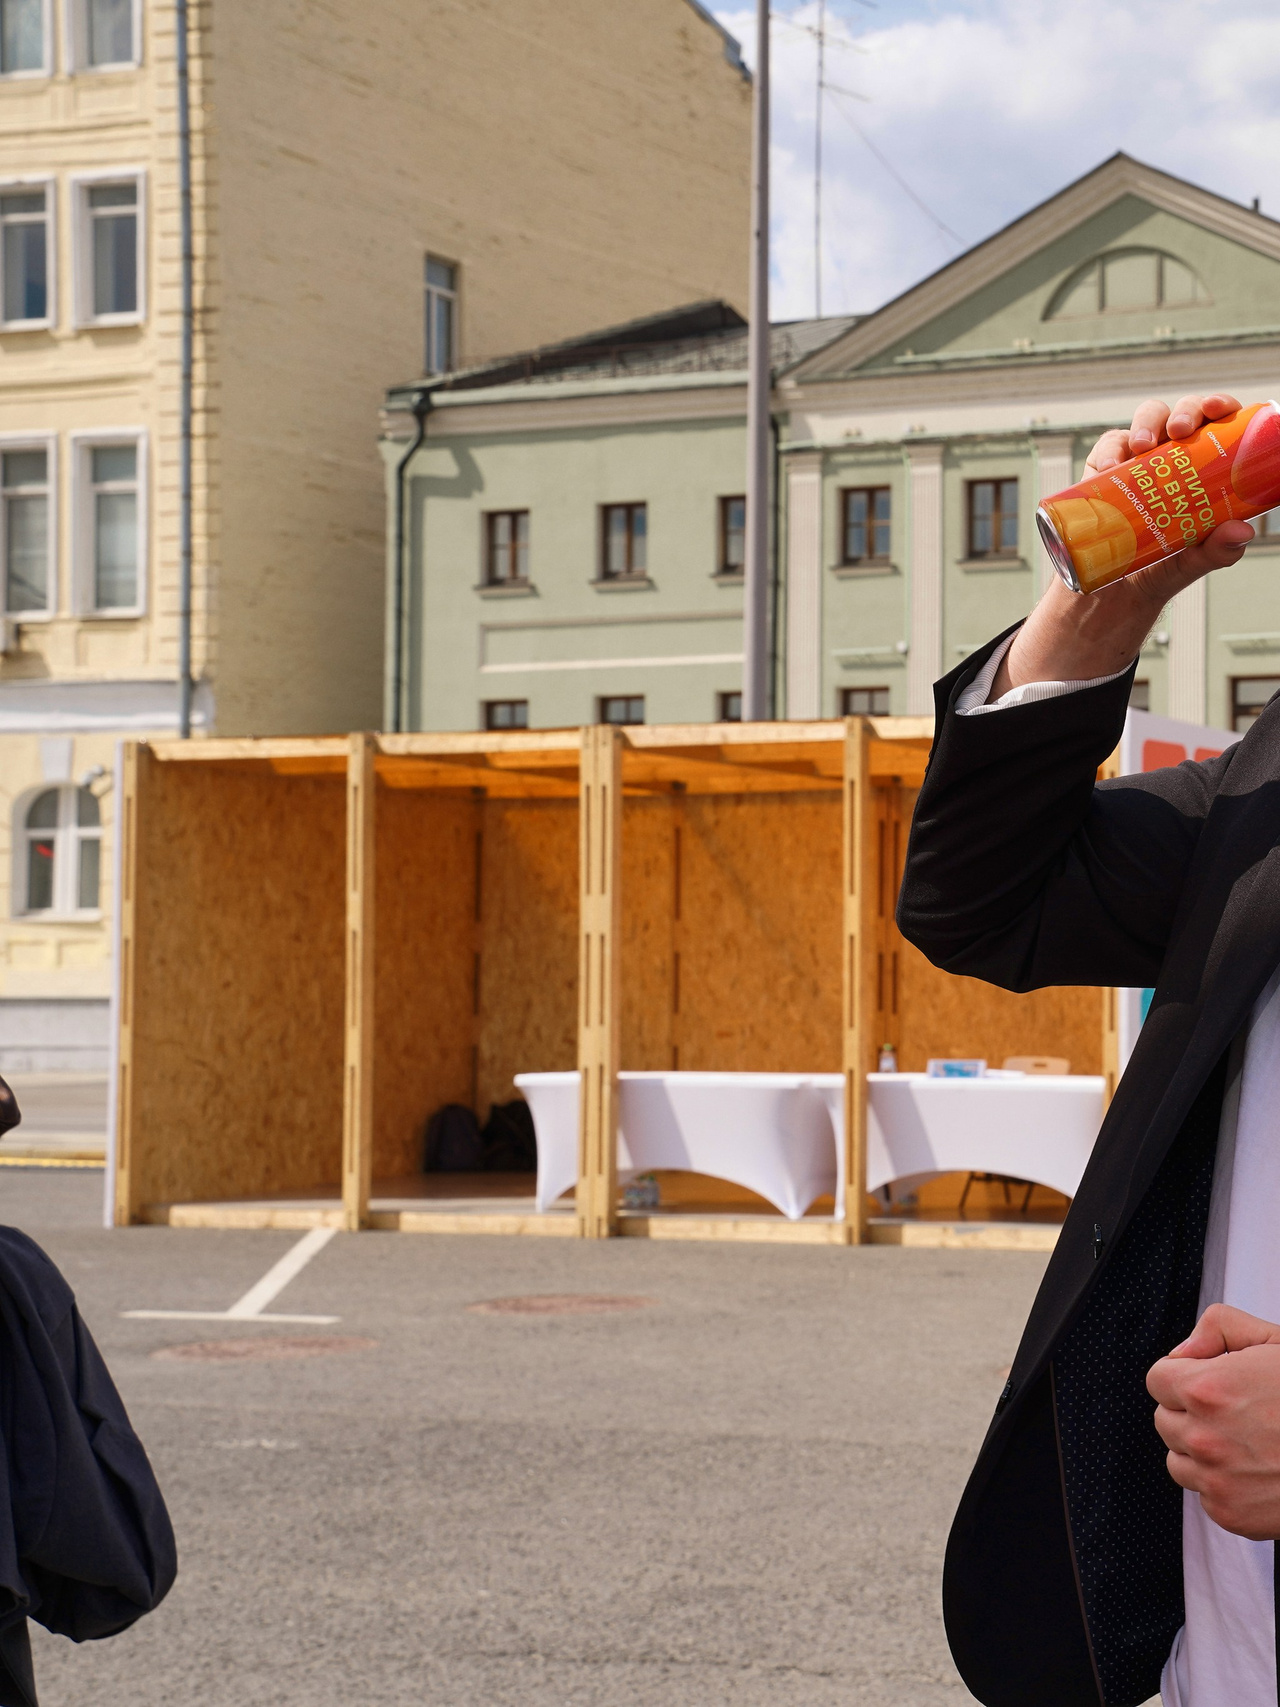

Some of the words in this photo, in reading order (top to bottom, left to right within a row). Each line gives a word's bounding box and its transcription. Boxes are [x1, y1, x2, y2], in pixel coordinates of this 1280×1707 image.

[1128, 463, 1171, 528] манго
[1149, 455, 1171, 478] со
[1167, 446, 1216, 532] напиток
